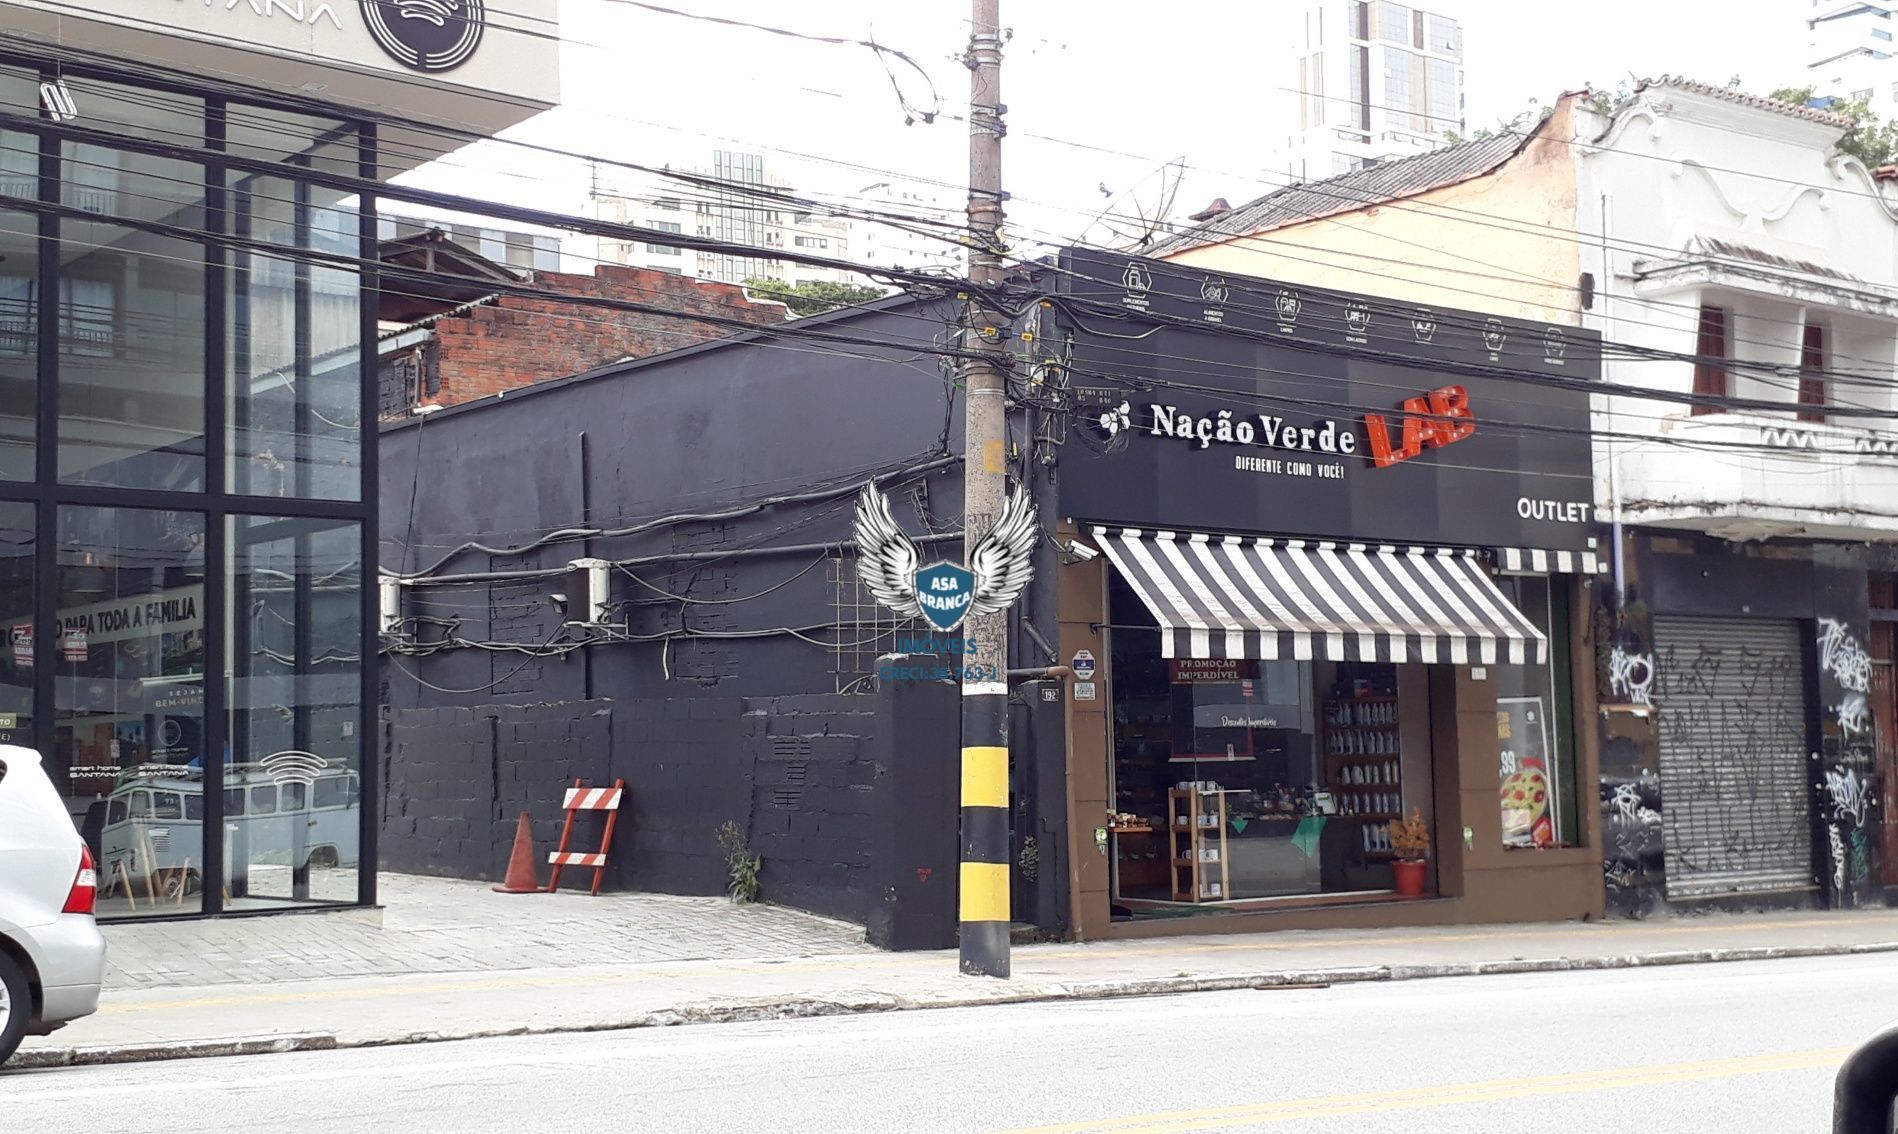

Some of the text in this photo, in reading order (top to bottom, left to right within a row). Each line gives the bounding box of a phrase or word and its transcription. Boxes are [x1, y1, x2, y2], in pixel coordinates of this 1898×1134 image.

[1151, 404, 1356, 454] Nação Verde
[1365, 384, 1476, 468] LAB
[1235, 455, 1345, 479] DIFERENTE COMO VOCÊ!
[1517, 498, 1589, 523] OUTLET
[97, 608, 130, 633] TODA
[132, 605, 143, 628] A
[1045, 690, 1056, 700] 192
